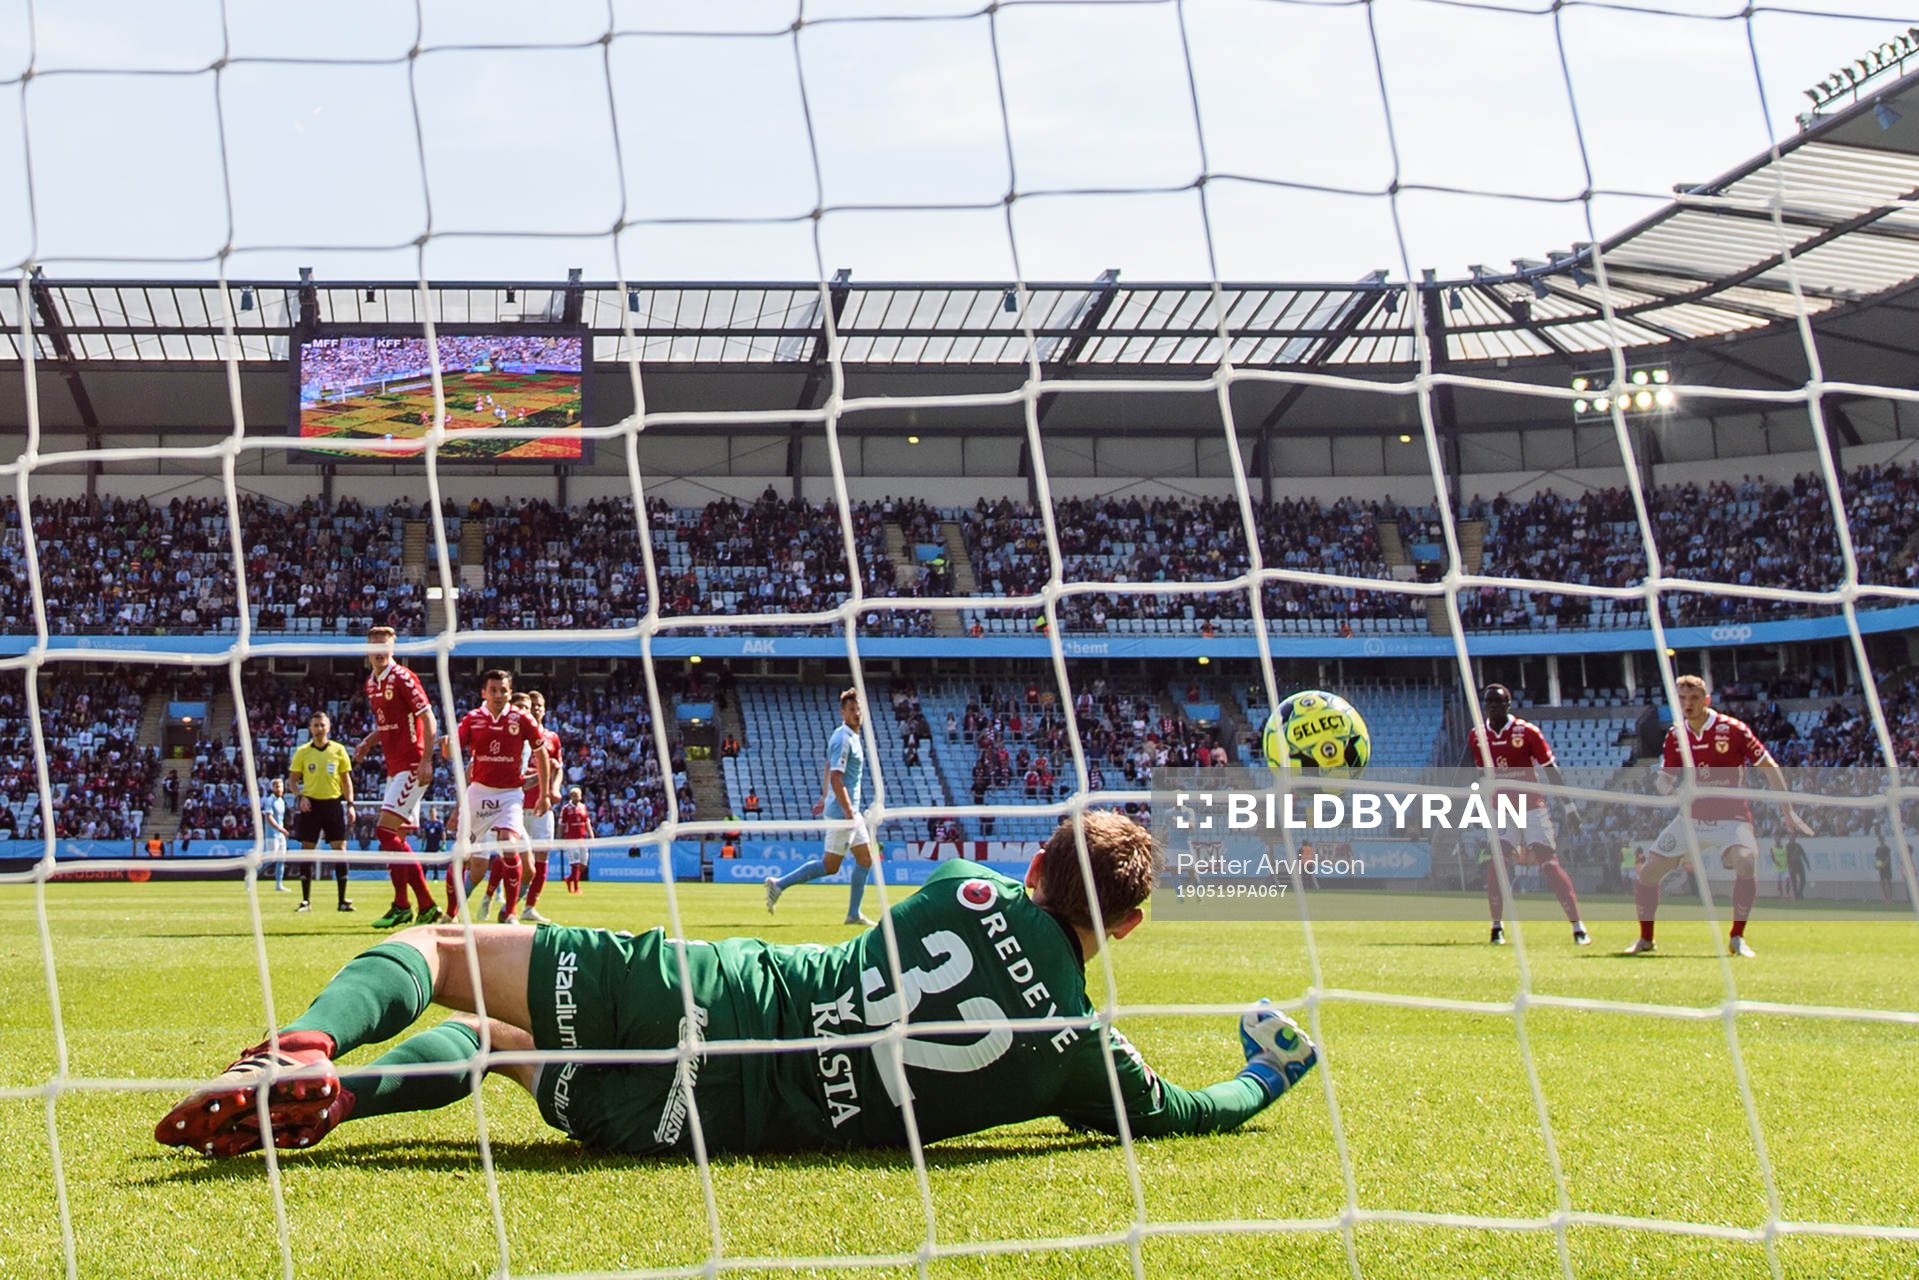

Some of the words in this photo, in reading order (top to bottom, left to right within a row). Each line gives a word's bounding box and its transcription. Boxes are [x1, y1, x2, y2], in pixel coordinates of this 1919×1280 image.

[312, 339, 339, 348] MFF
[743, 639, 777, 654] AAK
[1292, 714, 1346, 742] SELECT
[555, 951, 579, 1049] stadium
[861, 930, 1014, 1108] 32
[980, 911, 1080, 1053] REDEYE
[811, 1001, 862, 1129] RASTA
